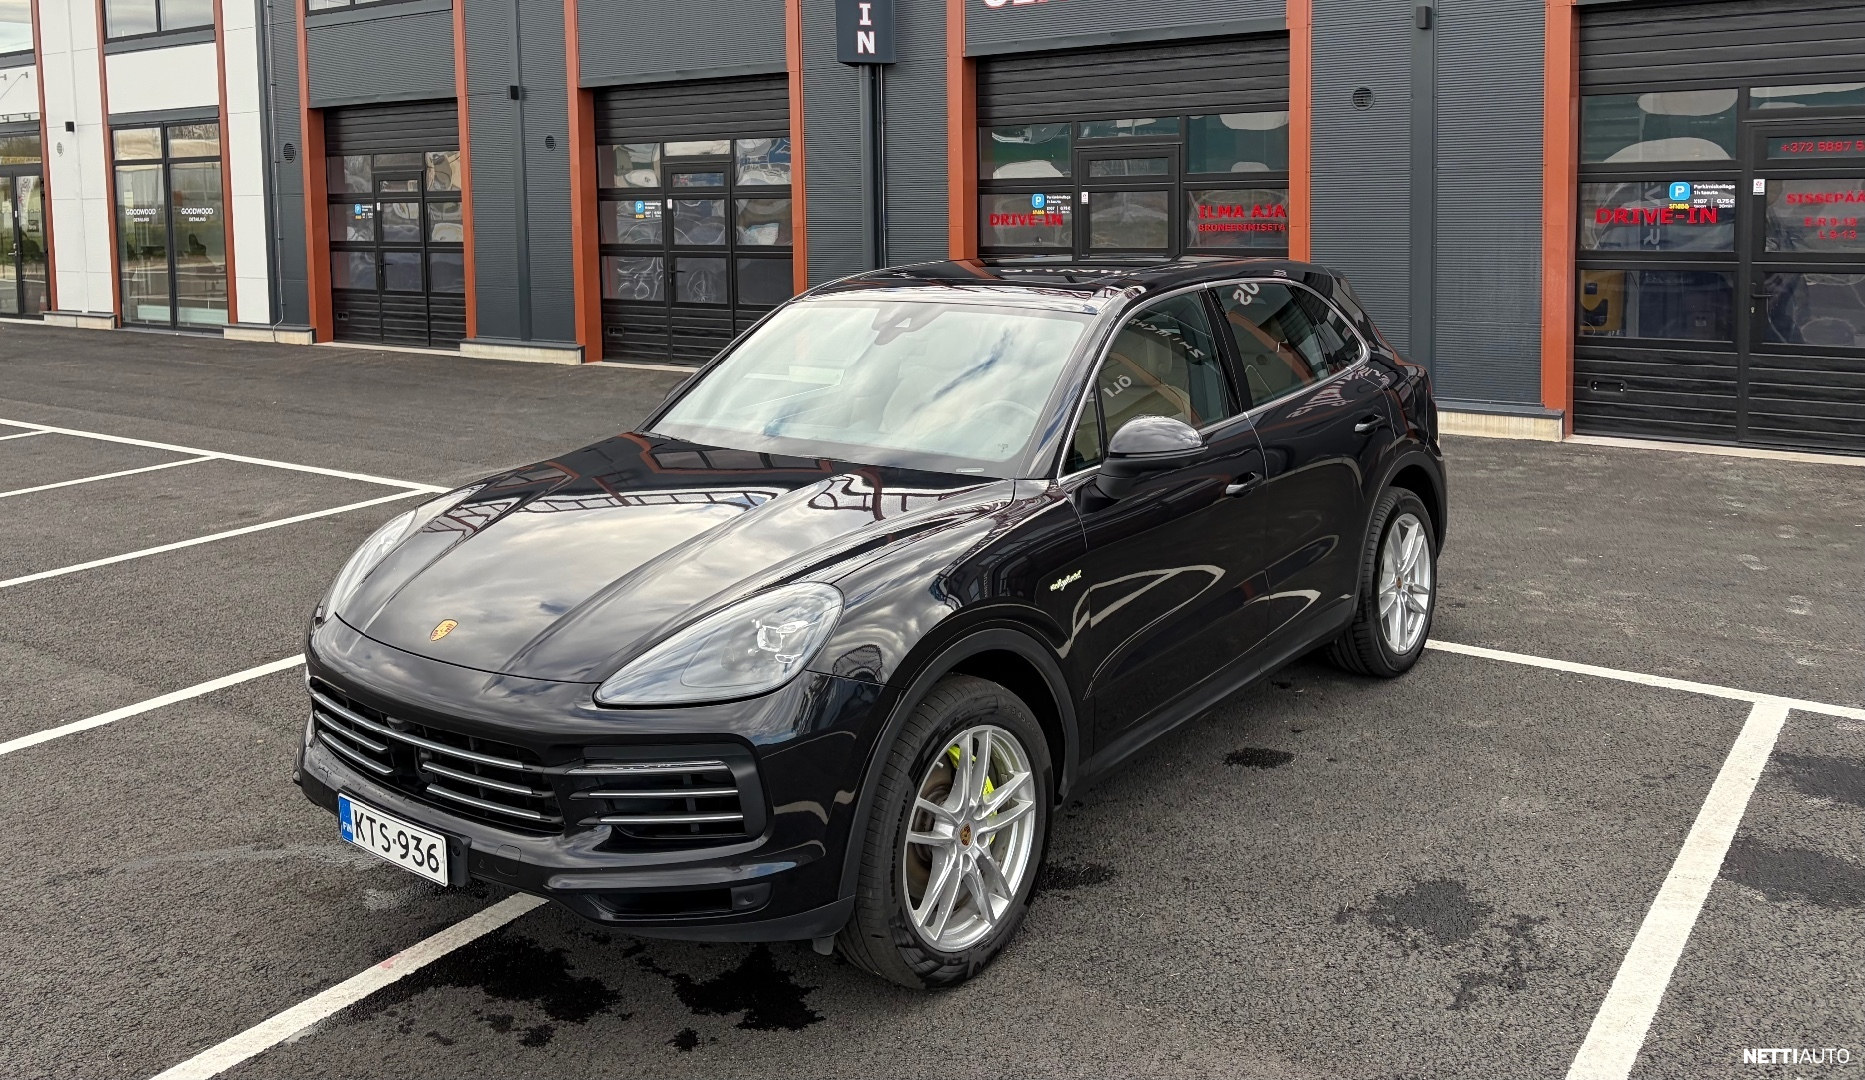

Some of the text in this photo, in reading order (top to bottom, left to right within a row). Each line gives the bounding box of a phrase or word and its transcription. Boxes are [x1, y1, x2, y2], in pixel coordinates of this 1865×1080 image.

[857, 2, 876, 54] IN
[1781, 142, 1814, 153] +372
[1817, 141, 1852, 152] 5887
[125, 208, 157, 216] GOODWOOD
[180, 207, 214, 215] GOODWOOD
[1198, 203, 1287, 219] ILMA AJA
[1595, 208, 1718, 224] DRIVE-IN
[989, 212, 1064, 227] DRIVE-IN
[353, 809, 441, 874] KTS-936
